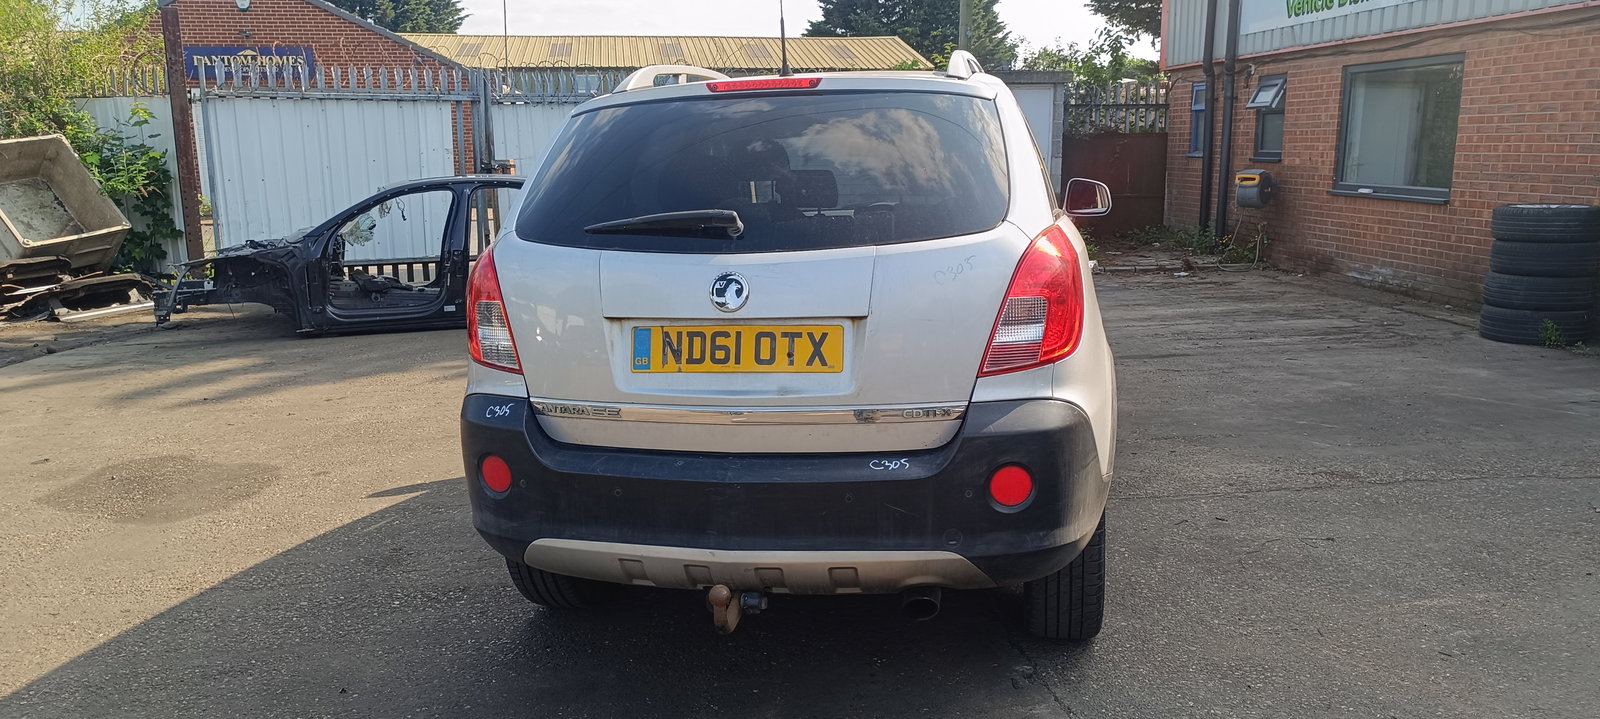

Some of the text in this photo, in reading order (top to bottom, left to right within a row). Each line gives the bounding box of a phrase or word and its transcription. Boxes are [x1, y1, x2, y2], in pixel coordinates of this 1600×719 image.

[257, 55, 305, 66] HOMES
[934, 254, 977, 286] C305
[662, 330, 829, 366] ND61 OTX
[634, 356, 649, 365] GB
[485, 403, 515, 418] C305
[541, 403, 590, 416] ANTARA
[869, 458, 909, 470] C305
